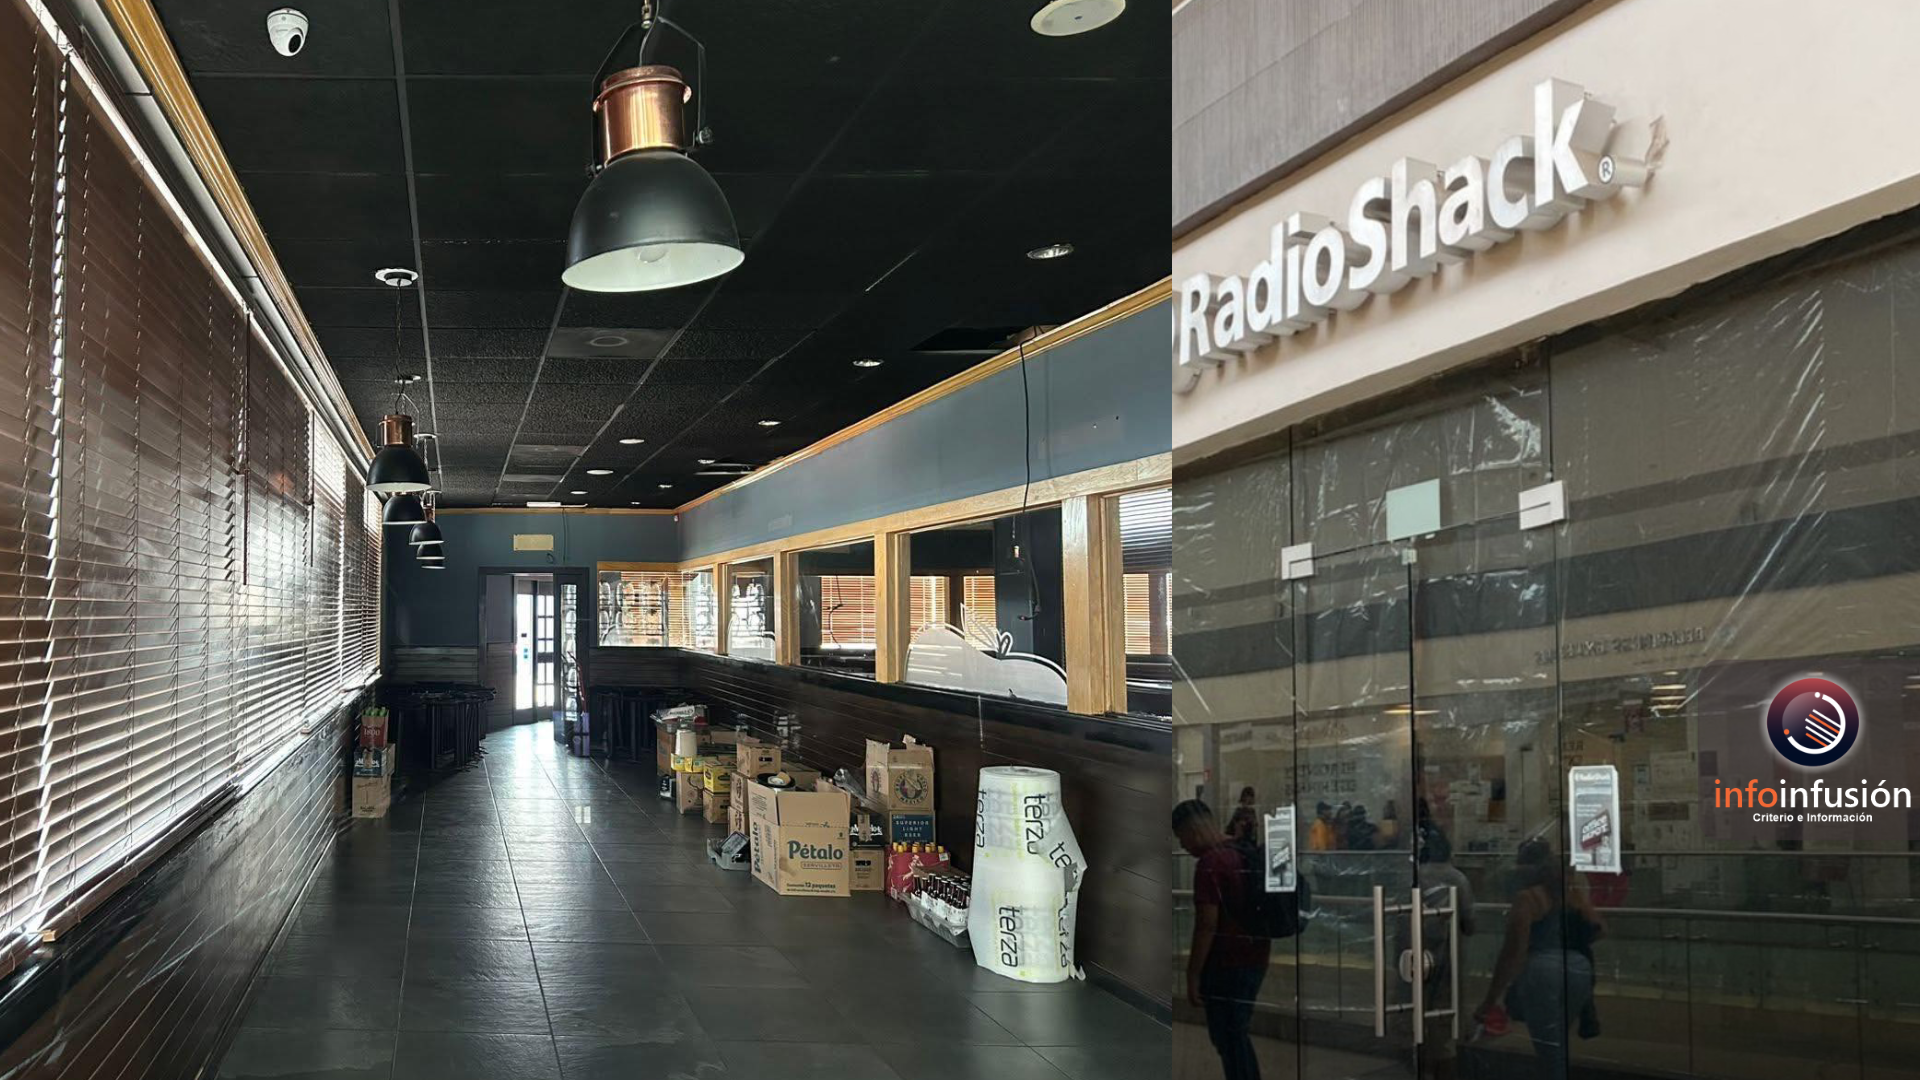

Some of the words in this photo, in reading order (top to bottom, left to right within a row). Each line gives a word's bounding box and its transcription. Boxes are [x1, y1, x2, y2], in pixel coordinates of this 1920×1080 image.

[1178, 77, 1605, 367] RadioShack
[787, 840, 843, 860] Pétalo
[998, 905, 1021, 969] terza
